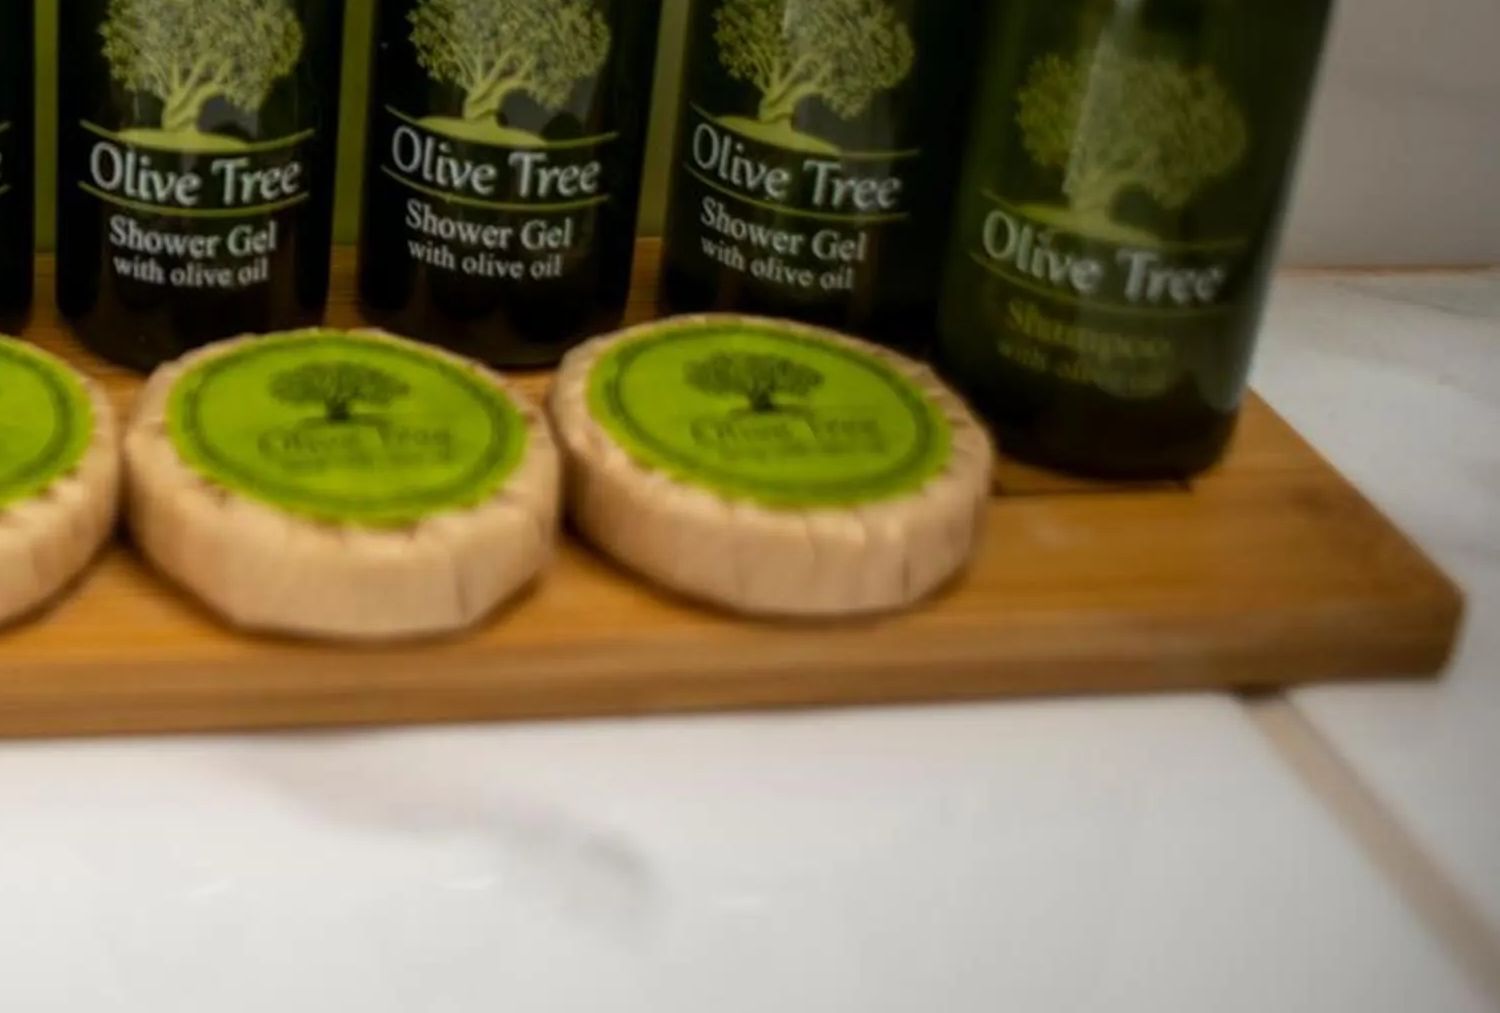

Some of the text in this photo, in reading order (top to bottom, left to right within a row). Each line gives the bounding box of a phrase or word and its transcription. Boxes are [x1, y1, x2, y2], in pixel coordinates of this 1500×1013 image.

[89, 141, 303, 207] Olive Tree
[391, 125, 602, 199] Olive Tree
[692, 123, 904, 210] Olive Tree
[109, 214, 278, 259] Shower Gel
[405, 197, 575, 251] Shower Gel
[701, 195, 868, 262] Shower Gel
[113, 254, 270, 288] with olive oil
[407, 238, 564, 281] with olive oil
[701, 236, 855, 290] with olive oil
[982, 209, 1228, 305] Olive Tree
